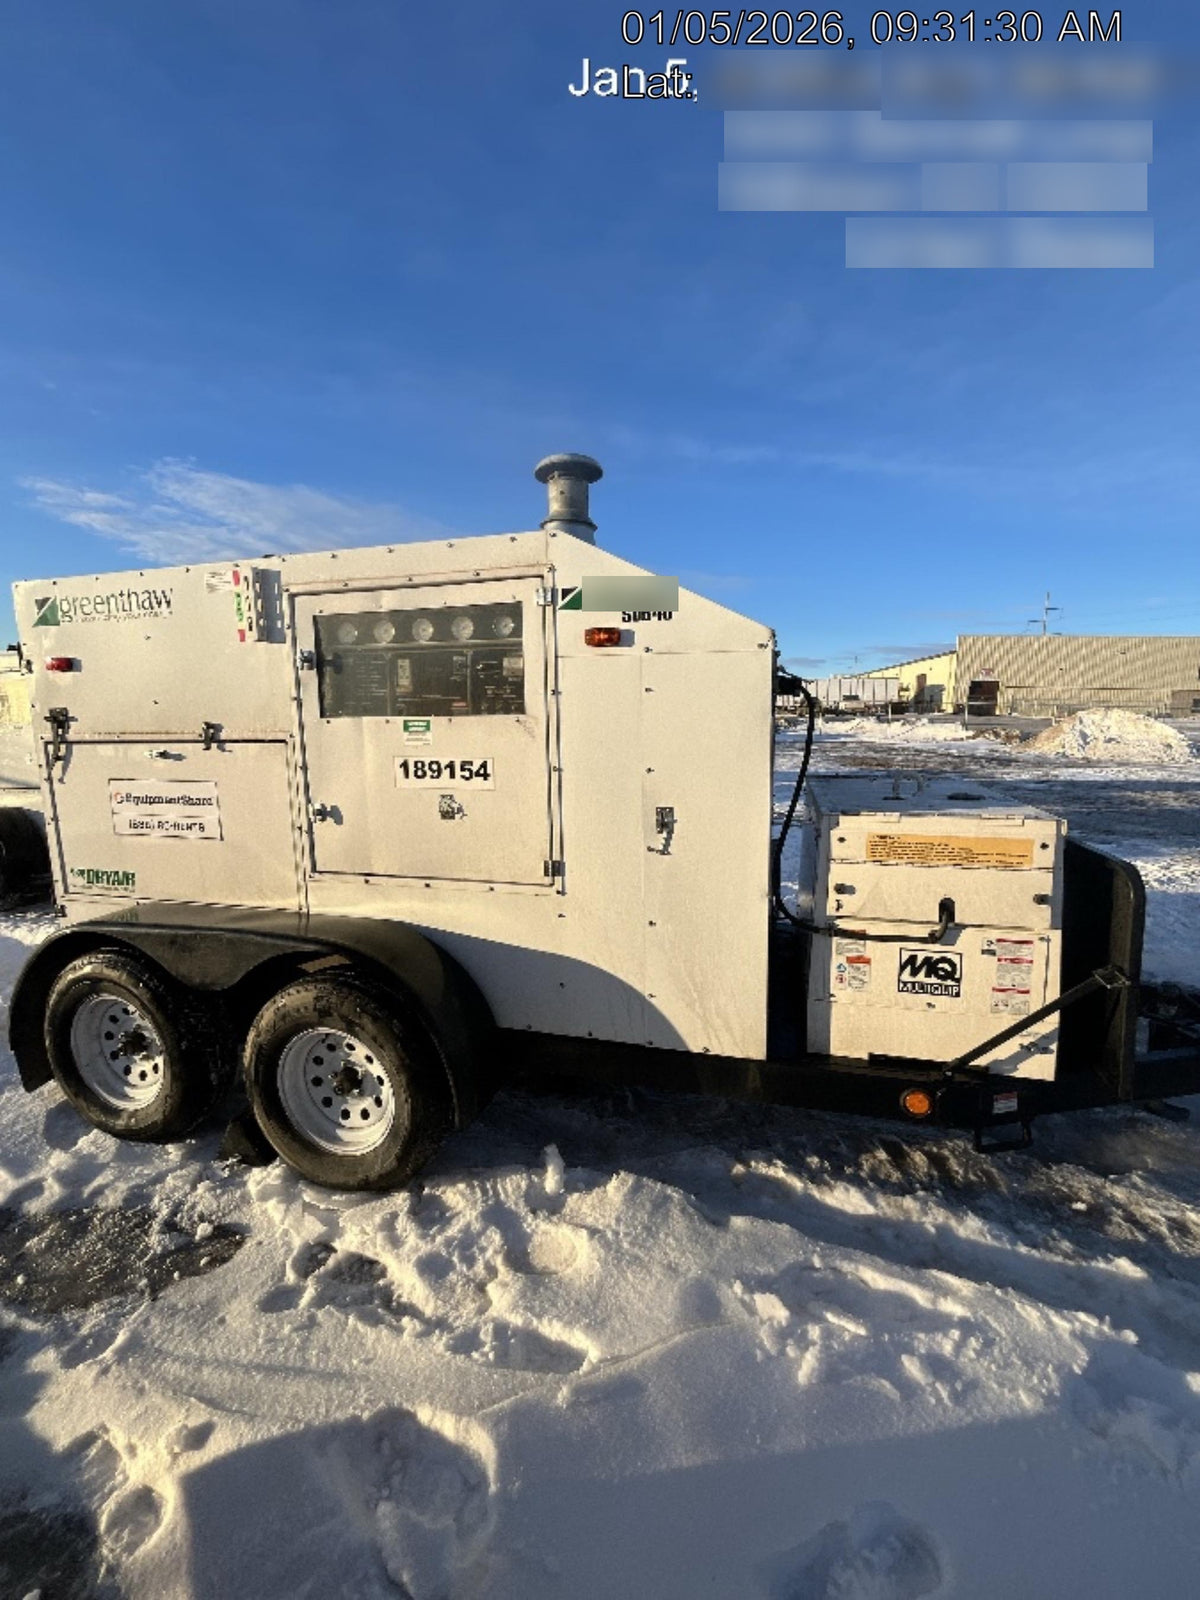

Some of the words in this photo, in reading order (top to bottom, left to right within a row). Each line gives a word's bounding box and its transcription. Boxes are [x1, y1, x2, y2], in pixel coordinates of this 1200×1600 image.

[60, 588, 173, 623] greenthaw
[399, 759, 491, 781] 189154
[900, 954, 960, 983] MQ
